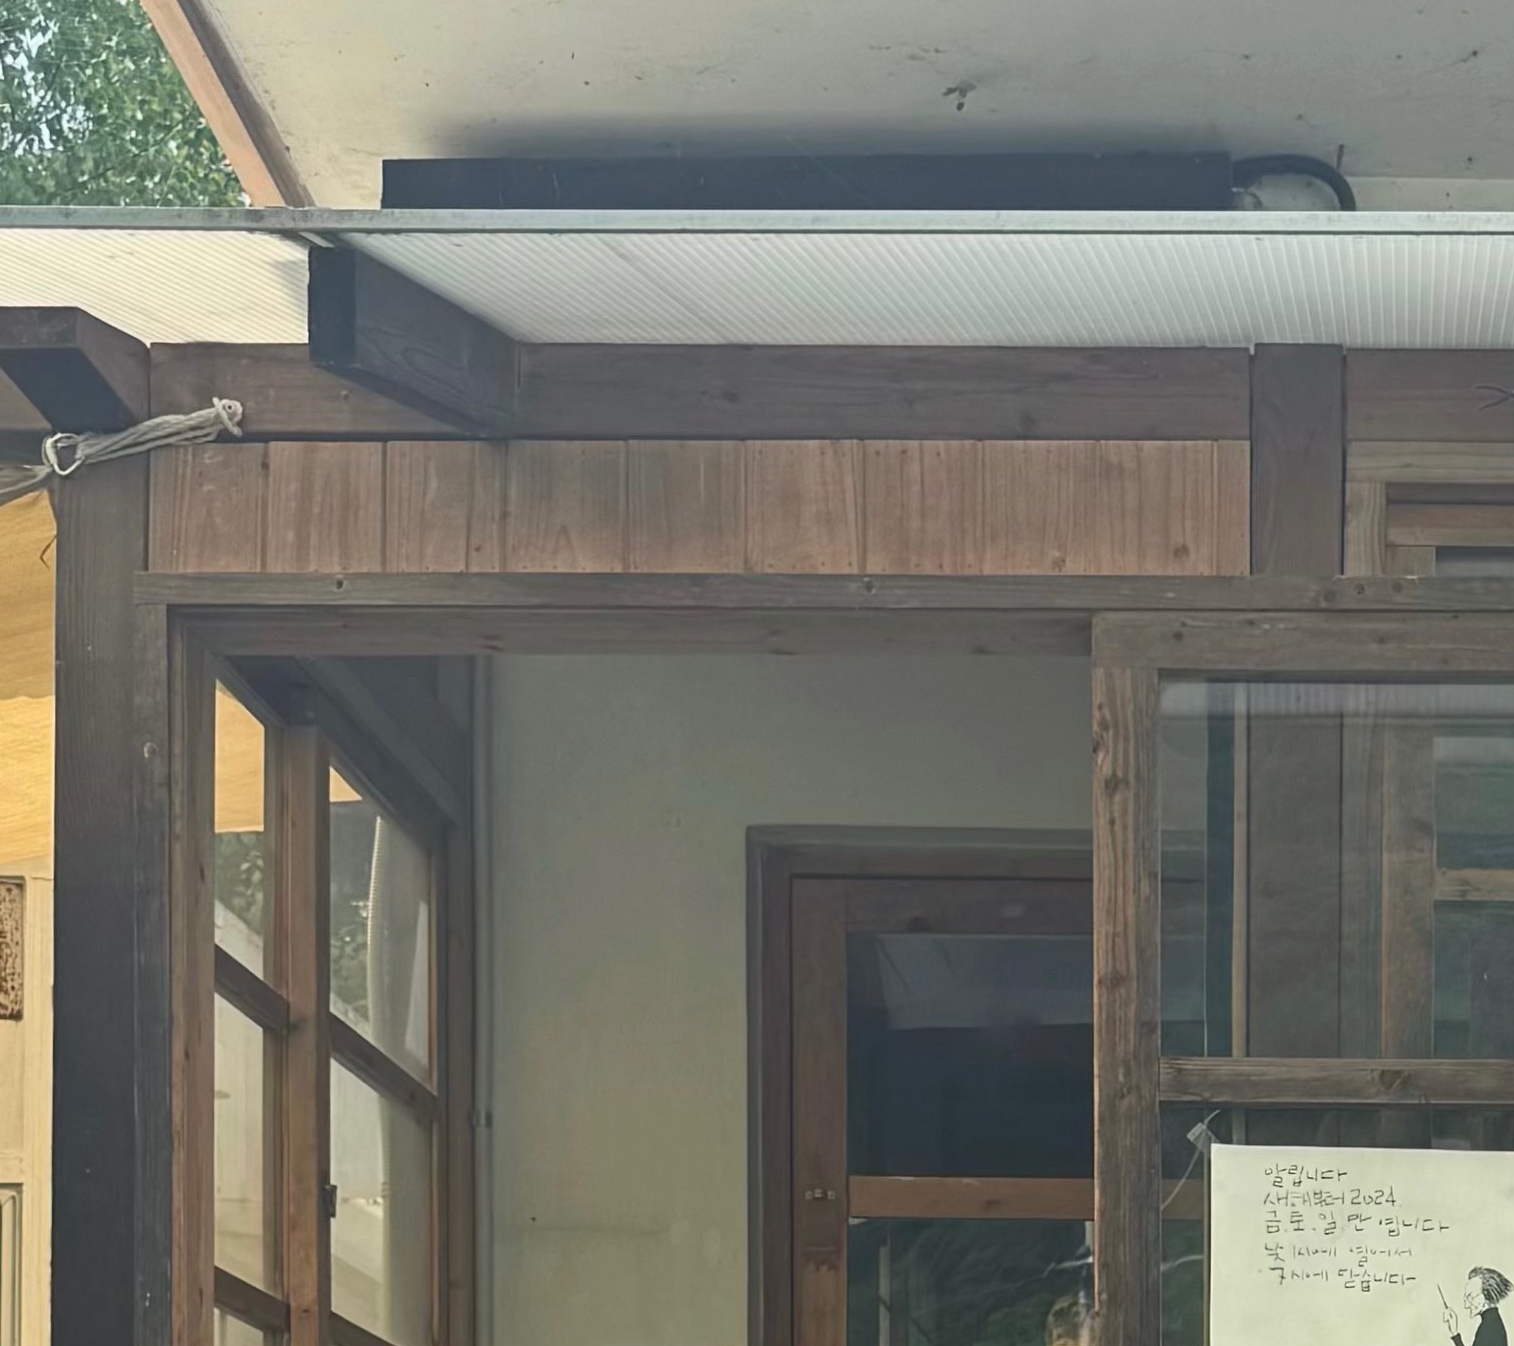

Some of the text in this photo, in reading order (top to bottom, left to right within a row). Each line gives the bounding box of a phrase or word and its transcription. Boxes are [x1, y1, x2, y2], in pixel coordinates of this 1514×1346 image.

[1264, 1162, 1348, 1188] 알립니다
[1263, 1185, 1398, 1208] 새해부터 2024
[1264, 1242, 1286, 1262] 낮
[1293, 1244, 1337, 1258] 1시에
[1337, 1267, 1417, 1292] 닫습니다
